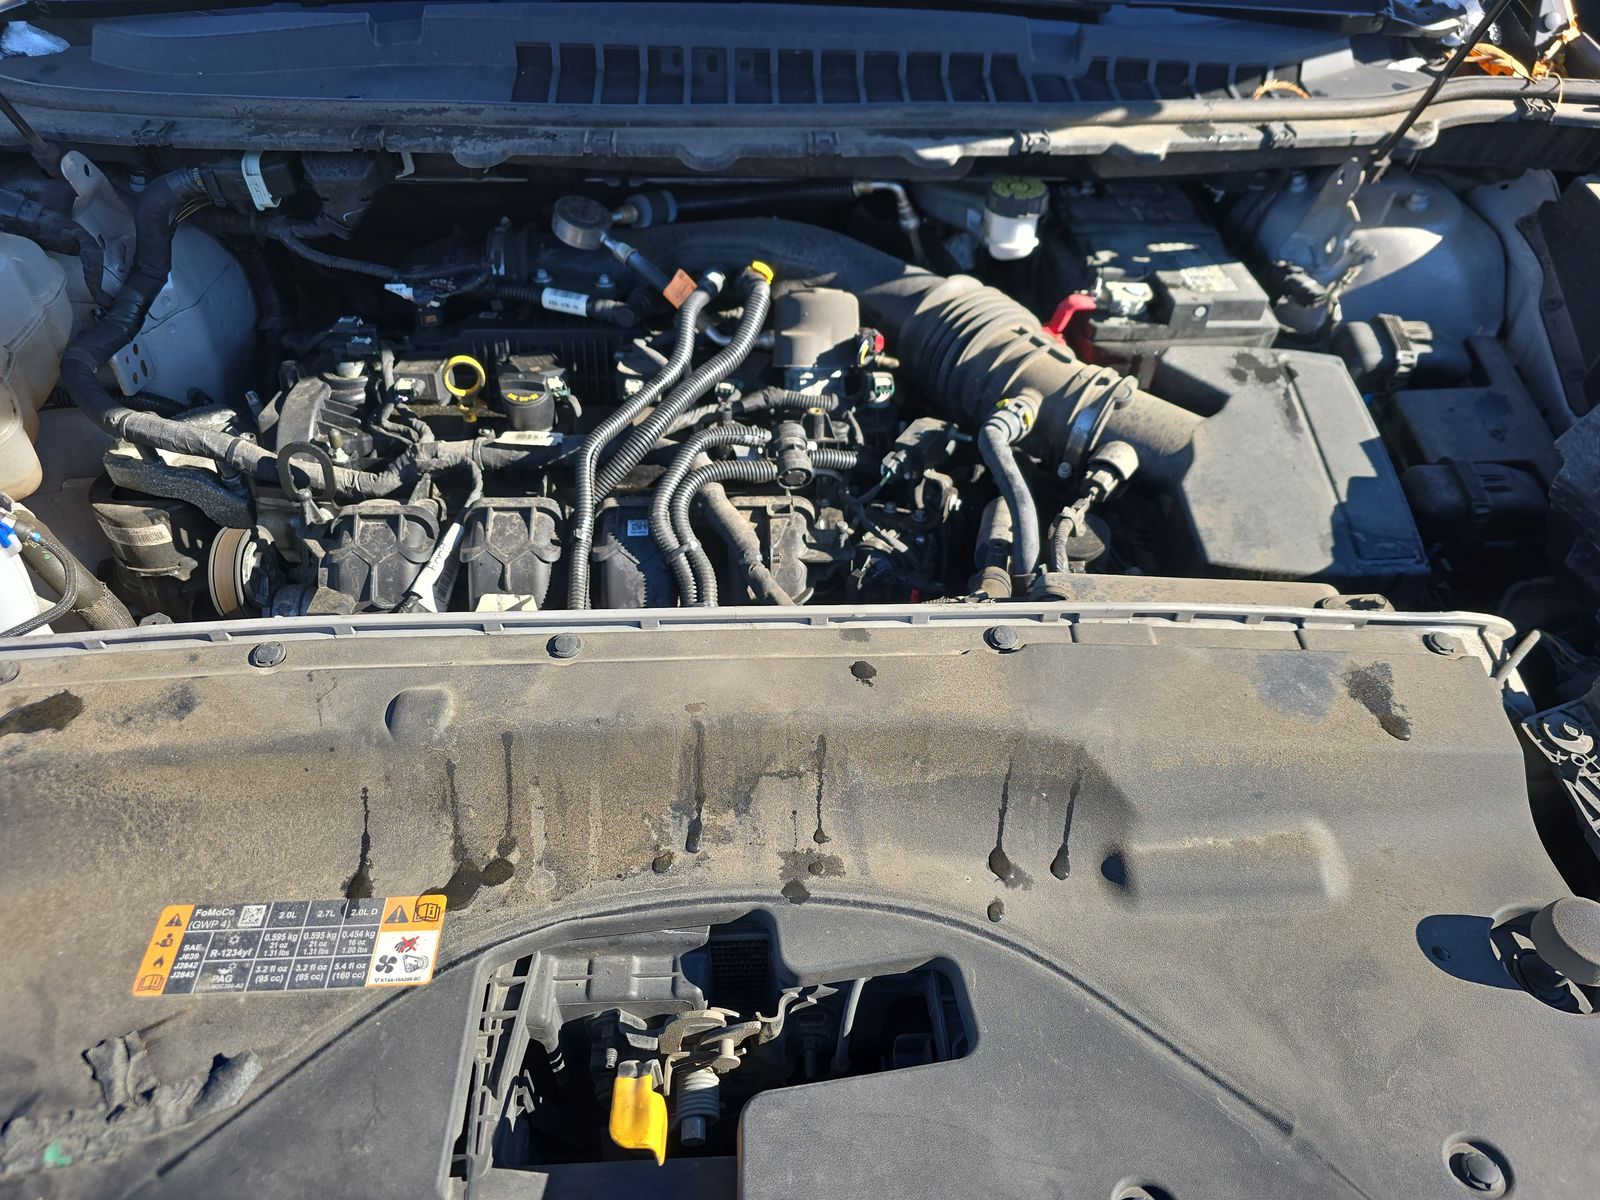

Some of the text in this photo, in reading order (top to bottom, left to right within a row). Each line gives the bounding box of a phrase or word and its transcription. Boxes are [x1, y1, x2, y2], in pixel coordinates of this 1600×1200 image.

[195, 908, 235, 917] FoMoCo
[278, 911, 298, 920] 2.0L
[316, 909, 336, 918] 2.7L
[350, 908, 378, 917] 2.0L D
[188, 919, 231, 931] (GWP 4)
[264, 932, 299, 944] 0.595 kg
[303, 931, 338, 943] 0.595 kg
[341, 930, 376, 940] 0.454 kg
[183, 944, 202, 952] SAE
[318, 948, 330, 956] lbs
[179, 953, 200, 961] J639
[209, 948, 254, 959] R-1234yf
[174, 962, 199, 970] J2842
[255, 966, 271, 975] 3.2
[277, 966, 289, 974] oz
[295, 965, 311, 973] 3.2
[170, 971, 196, 979] J2845
[212, 975, 234, 983] PAG
[254, 975, 284, 984] (95 cc)
[295, 973, 324, 982] (95 cc)
[332, 971, 366, 981] (160 cc)
